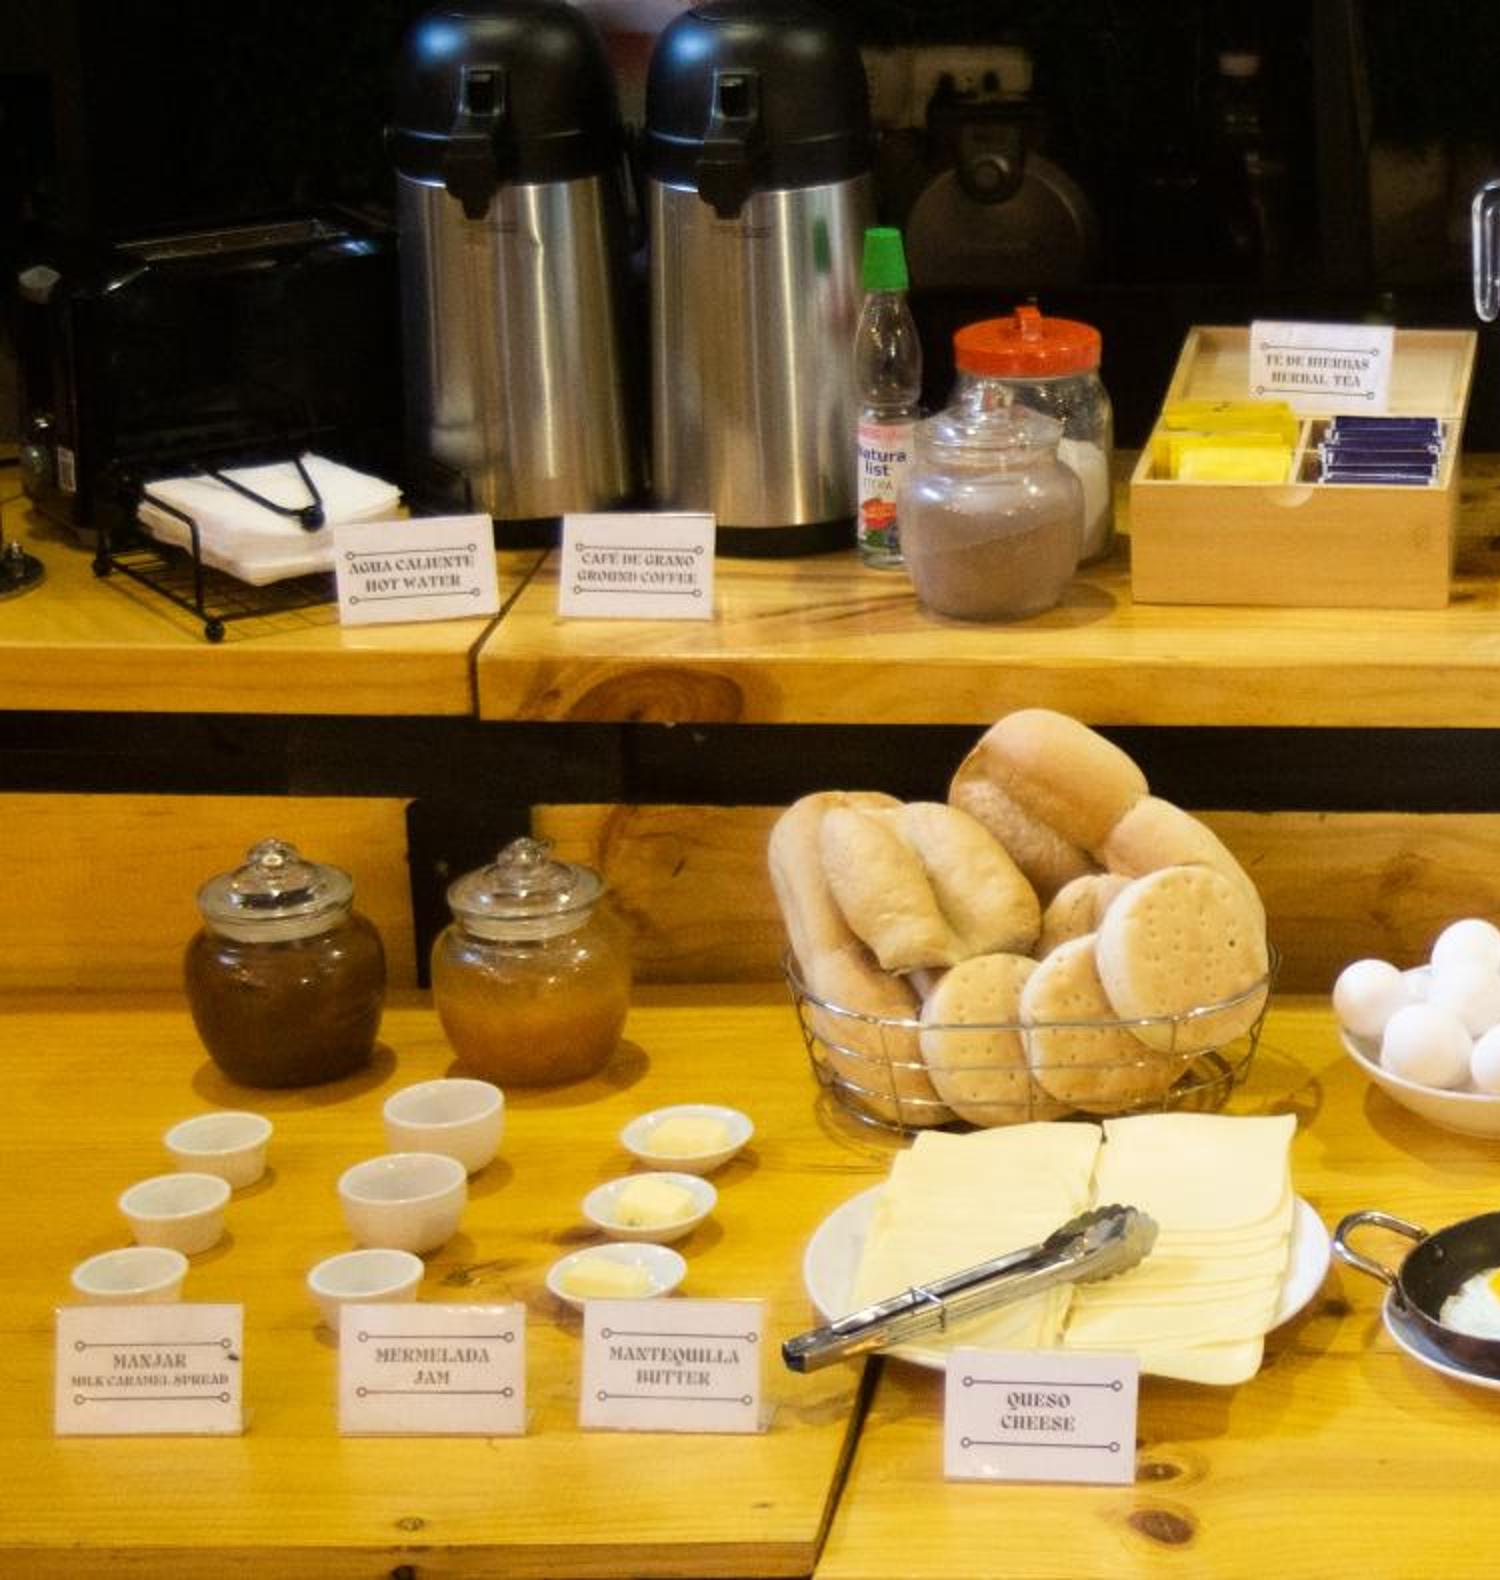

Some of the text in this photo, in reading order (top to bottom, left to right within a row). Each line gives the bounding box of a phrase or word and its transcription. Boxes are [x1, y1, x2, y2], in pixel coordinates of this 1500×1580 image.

[1307, 356, 1370, 369] HIERBAS
[1272, 371, 1361, 387] HERBAL TEA
[350, 554, 475, 575] AGUA CALIENTE
[622, 553, 642, 566] DE
[644, 554, 695, 567] GRANO
[365, 574, 461, 593] HOT WATER
[577, 570, 697, 585] GROUND COFFEE
[113, 1353, 187, 1369] MANJAR
[375, 1348, 490, 1363] MERMELADA
[609, 1347, 740, 1366] MANTEQUILLA
[71, 1373, 229, 1387] MILK CARAMEL SPREAD
[413, 1370, 450, 1385] JAM
[636, 1369, 711, 1386] BUTTER
[1006, 1391, 1071, 1410] QUESO
[1000, 1415, 1076, 1432] CHEESE
